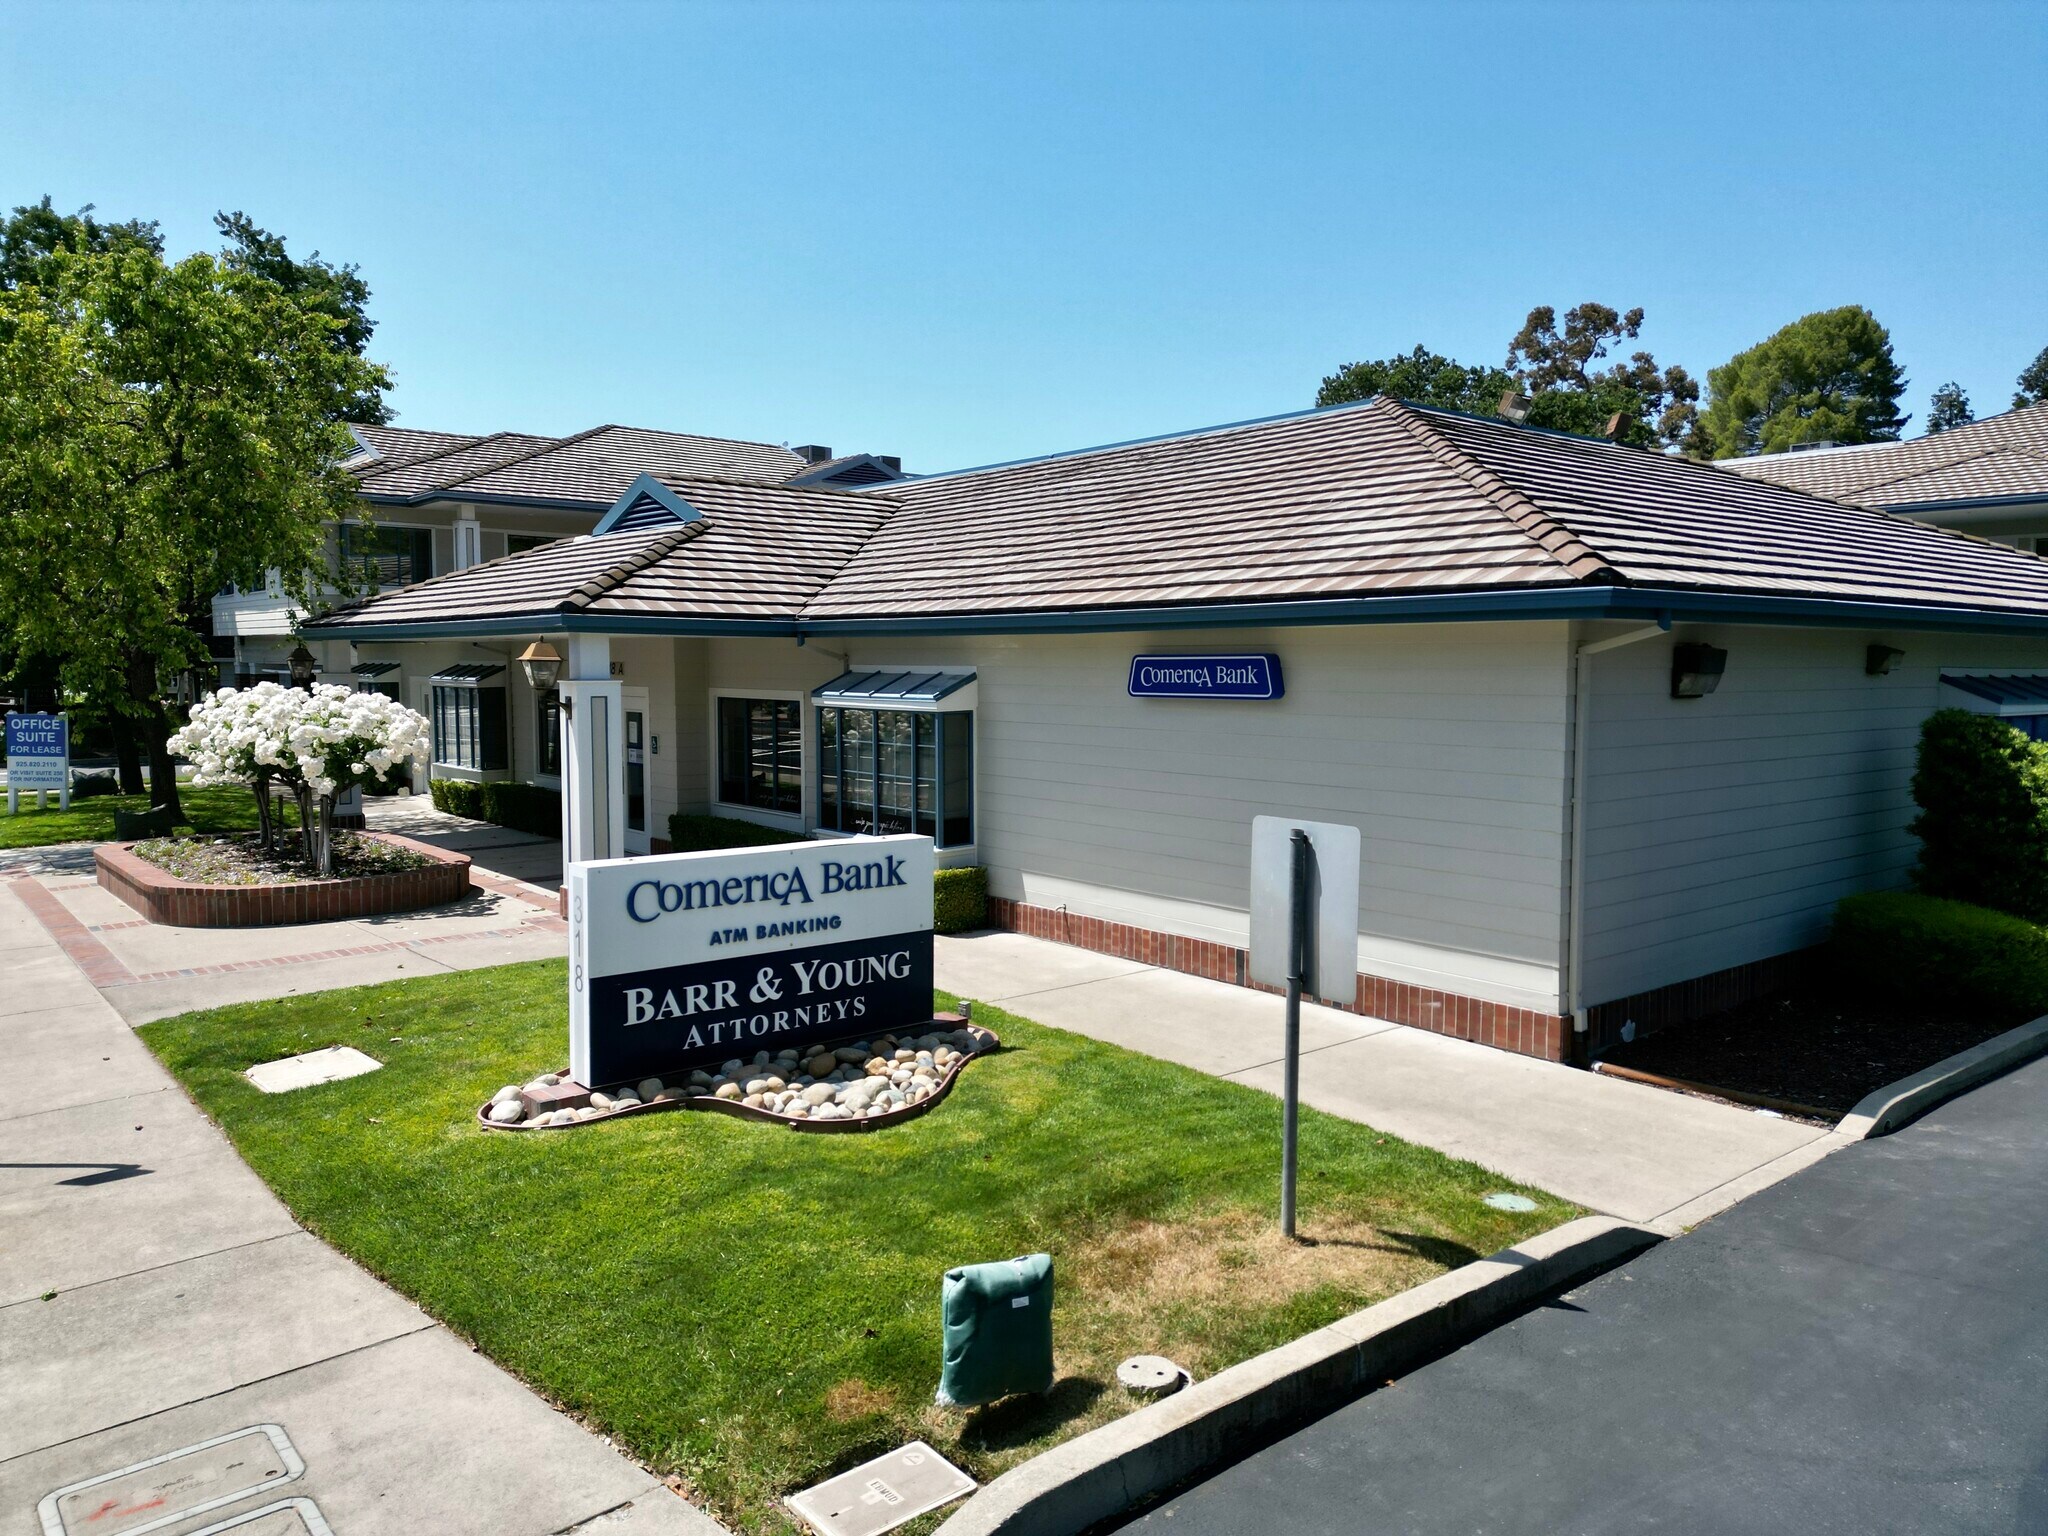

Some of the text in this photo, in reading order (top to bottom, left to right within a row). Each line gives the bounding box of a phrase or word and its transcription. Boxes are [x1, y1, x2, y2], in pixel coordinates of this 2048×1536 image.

[1216, 665, 1258, 684] Bank
[11, 719, 60, 730] OFFICE
[16, 731, 56, 742] SUITE
[10, 745, 62, 754] FOR LEASE
[820, 855, 907, 895] Bank
[709, 915, 842, 947] ATM BANKING
[622, 950, 912, 1027] BARR & YOUNG
[682, 996, 867, 1050] ATTORNEYS
